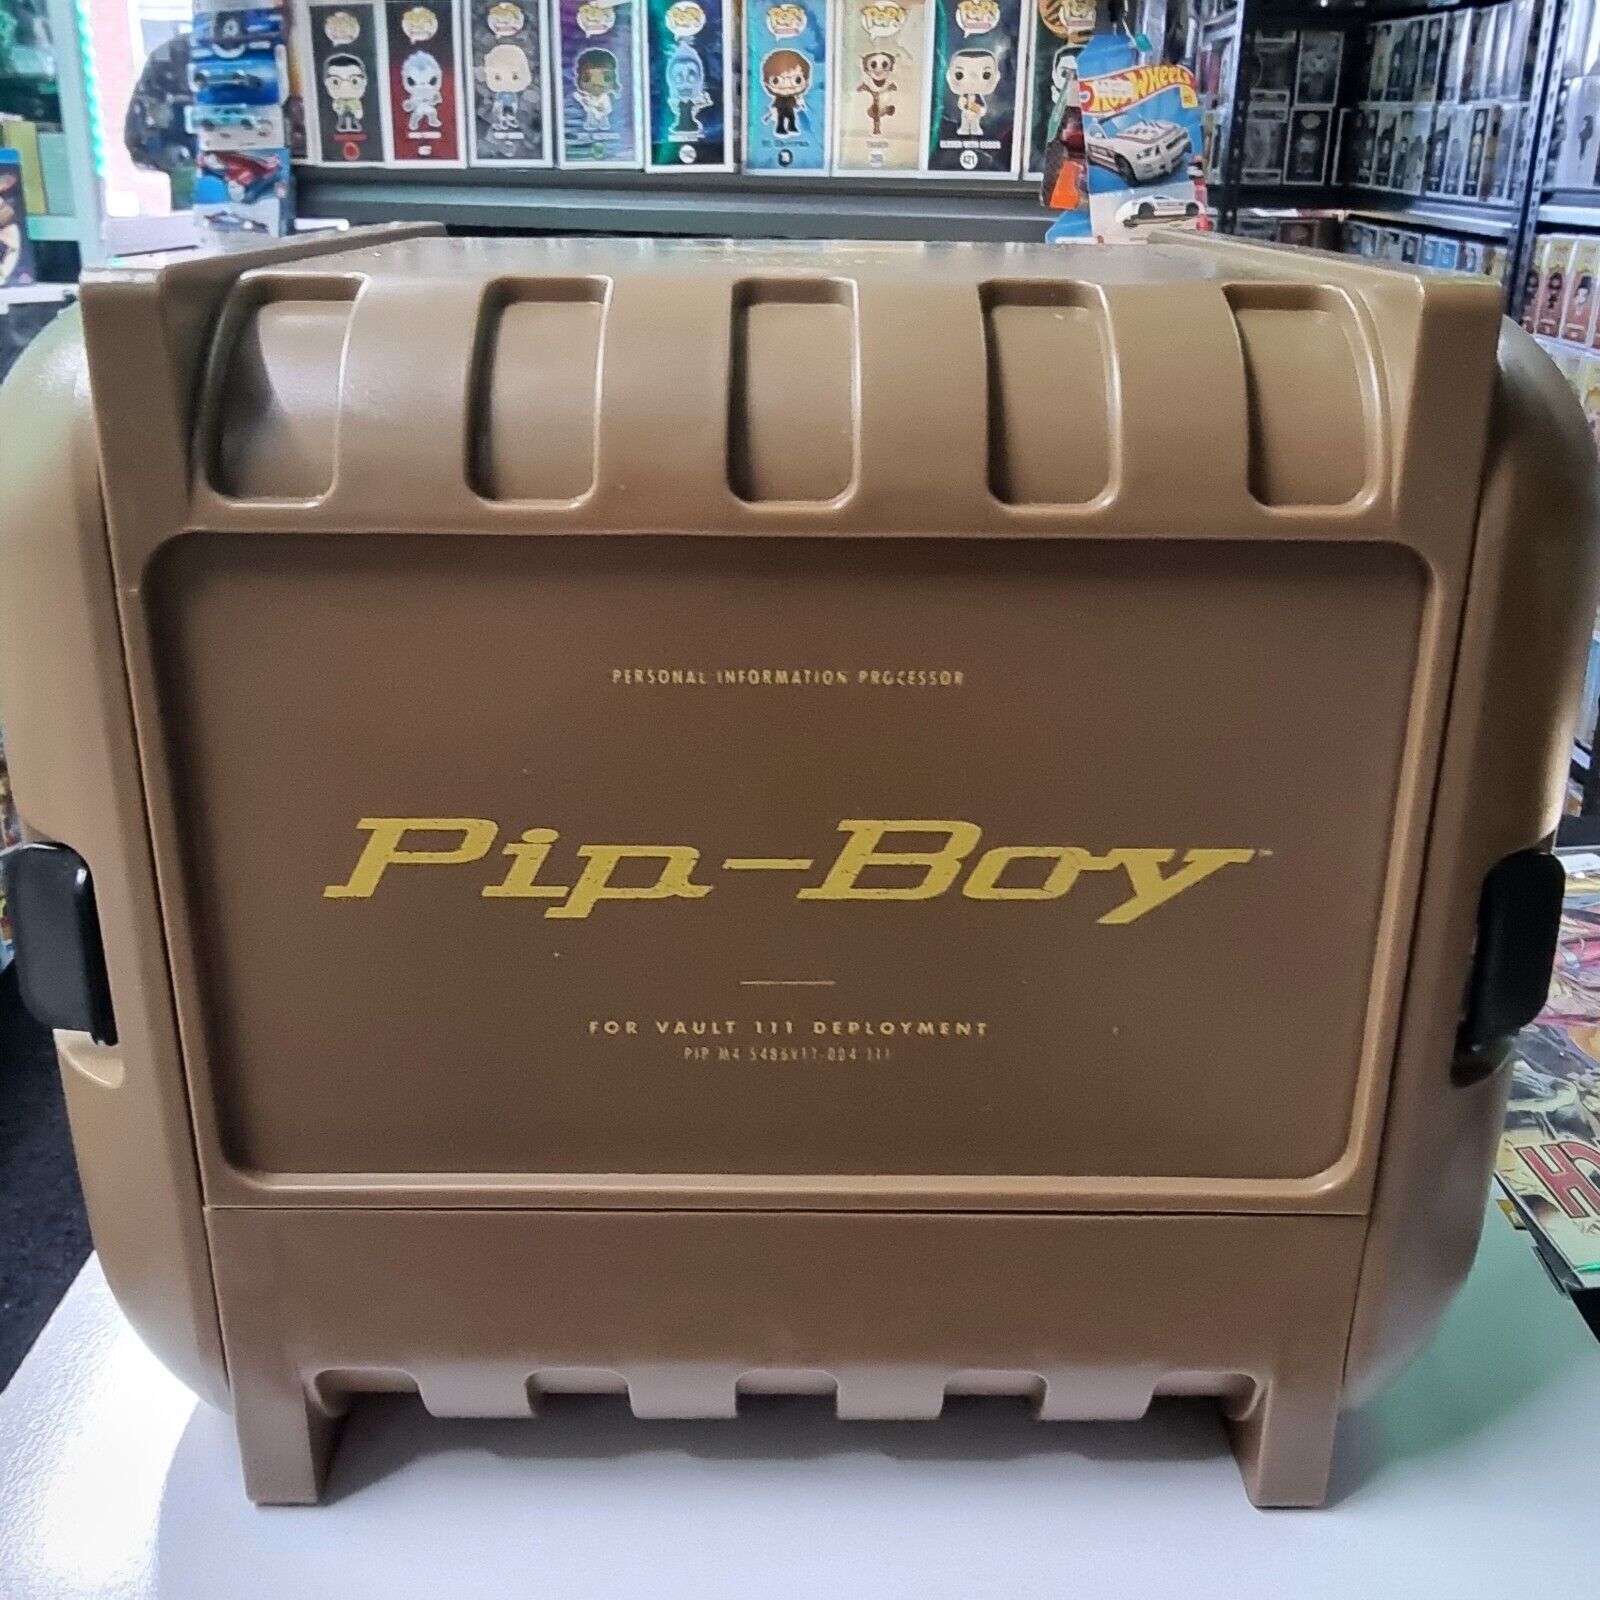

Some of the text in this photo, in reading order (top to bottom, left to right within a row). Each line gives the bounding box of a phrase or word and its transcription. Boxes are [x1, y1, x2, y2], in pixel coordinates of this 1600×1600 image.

[611, 668, 965, 687] PERSONAL INFORMATION PROCESSOR
[323, 817, 1258, 925] Pip-Boy
[588, 1020, 988, 1036] FOR VAULT 111 DEPLOYMENT
